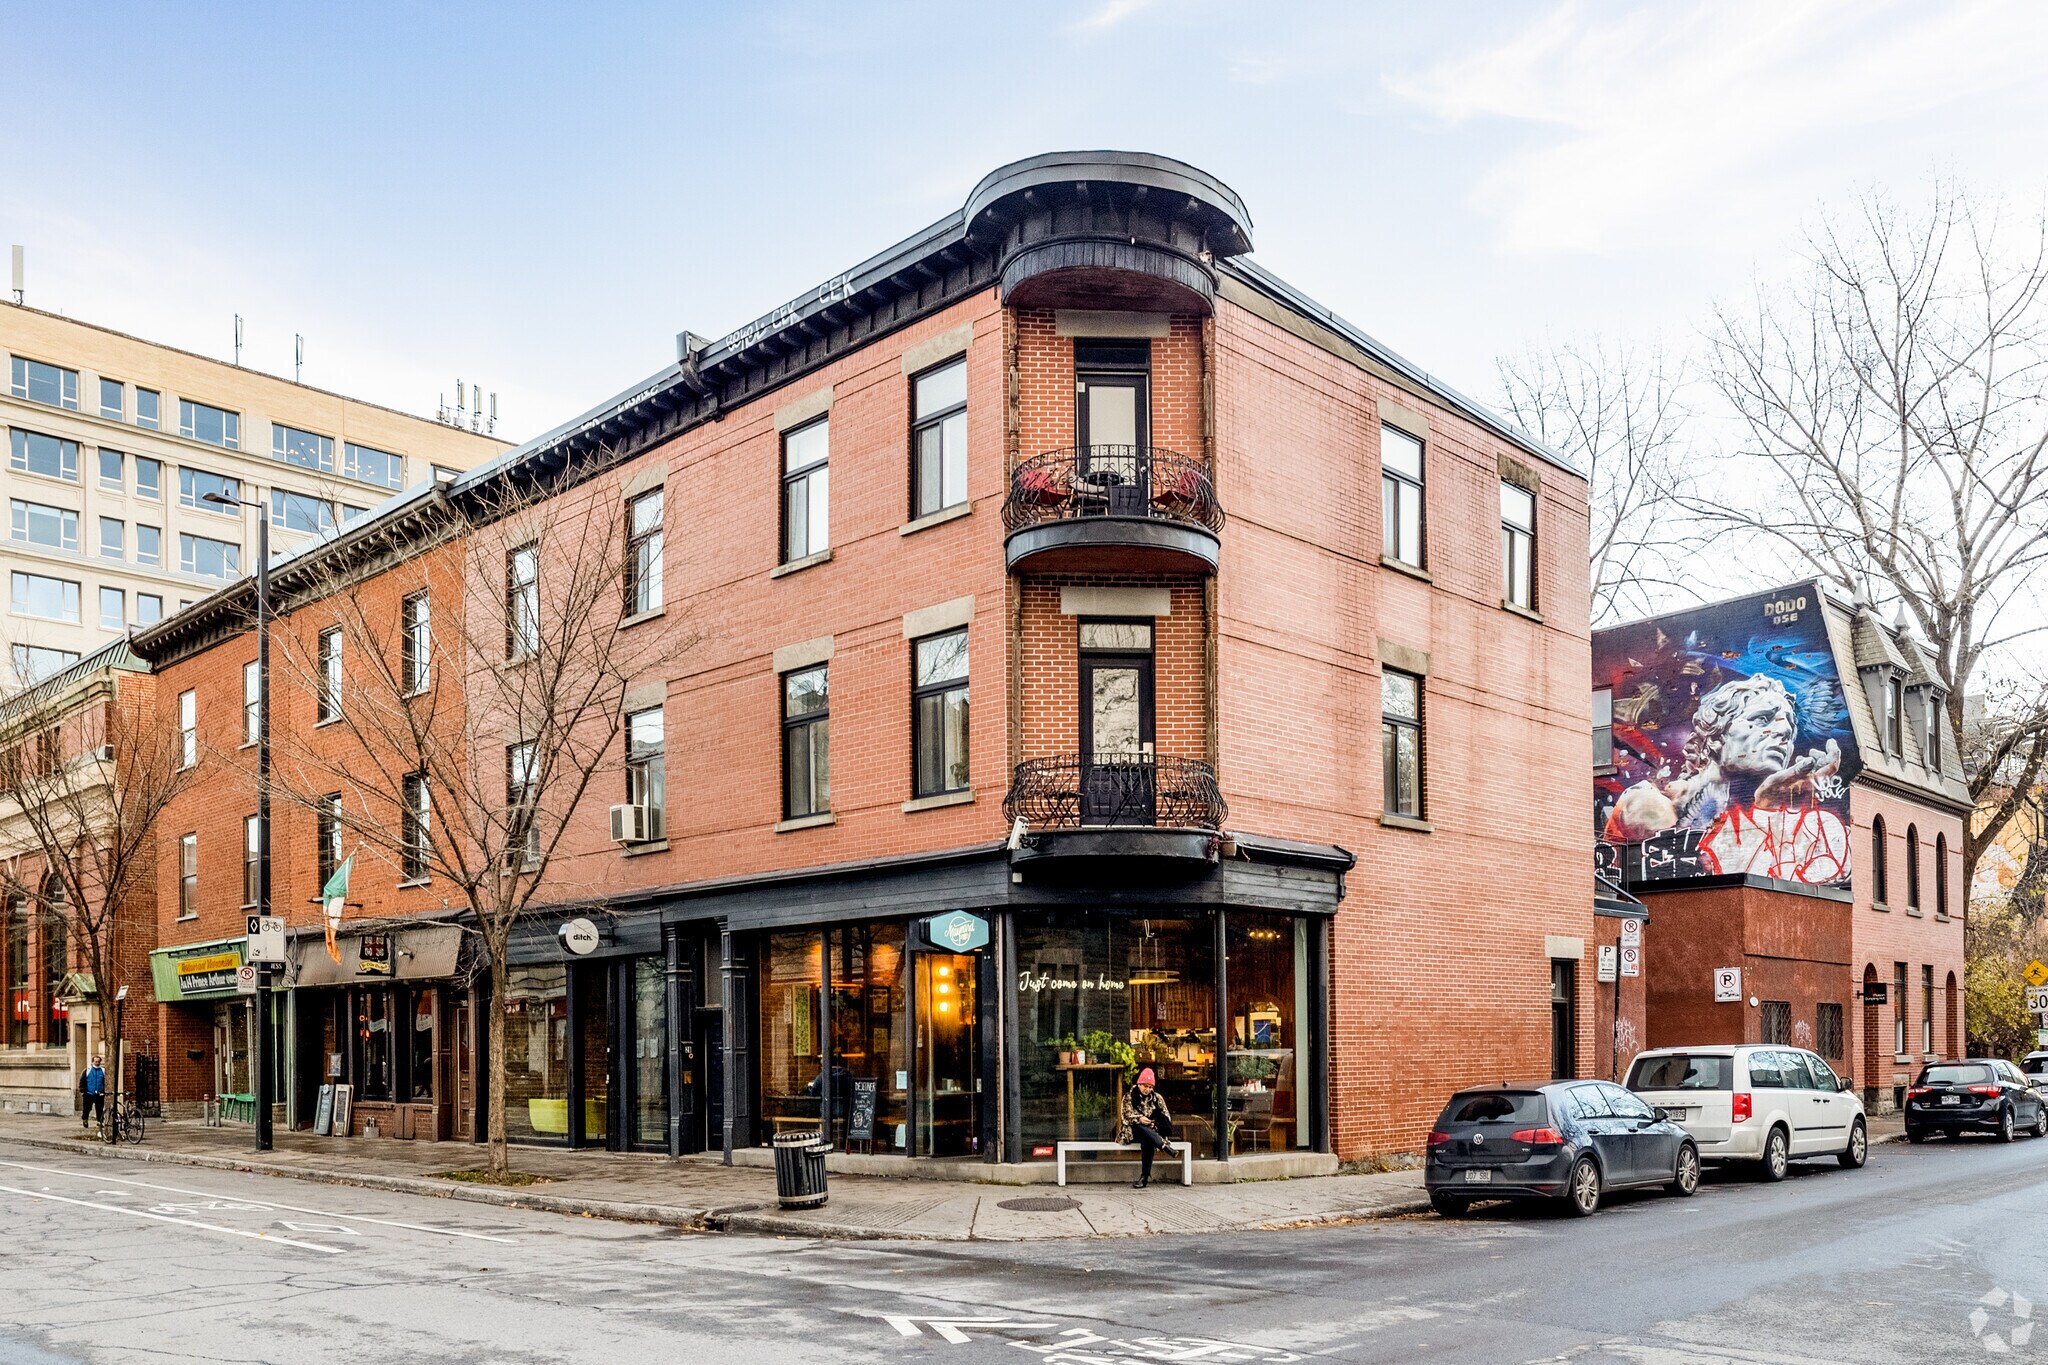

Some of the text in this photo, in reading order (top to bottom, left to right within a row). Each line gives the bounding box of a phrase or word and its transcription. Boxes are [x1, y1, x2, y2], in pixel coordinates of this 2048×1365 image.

[1764, 596, 1806, 616] DODO
[573, 933, 593, 941] ditch.
[1604, 946, 1611, 957] P
[1020, 971, 1125, 992] Just come on home
[2030, 994, 2048, 1009] 30
